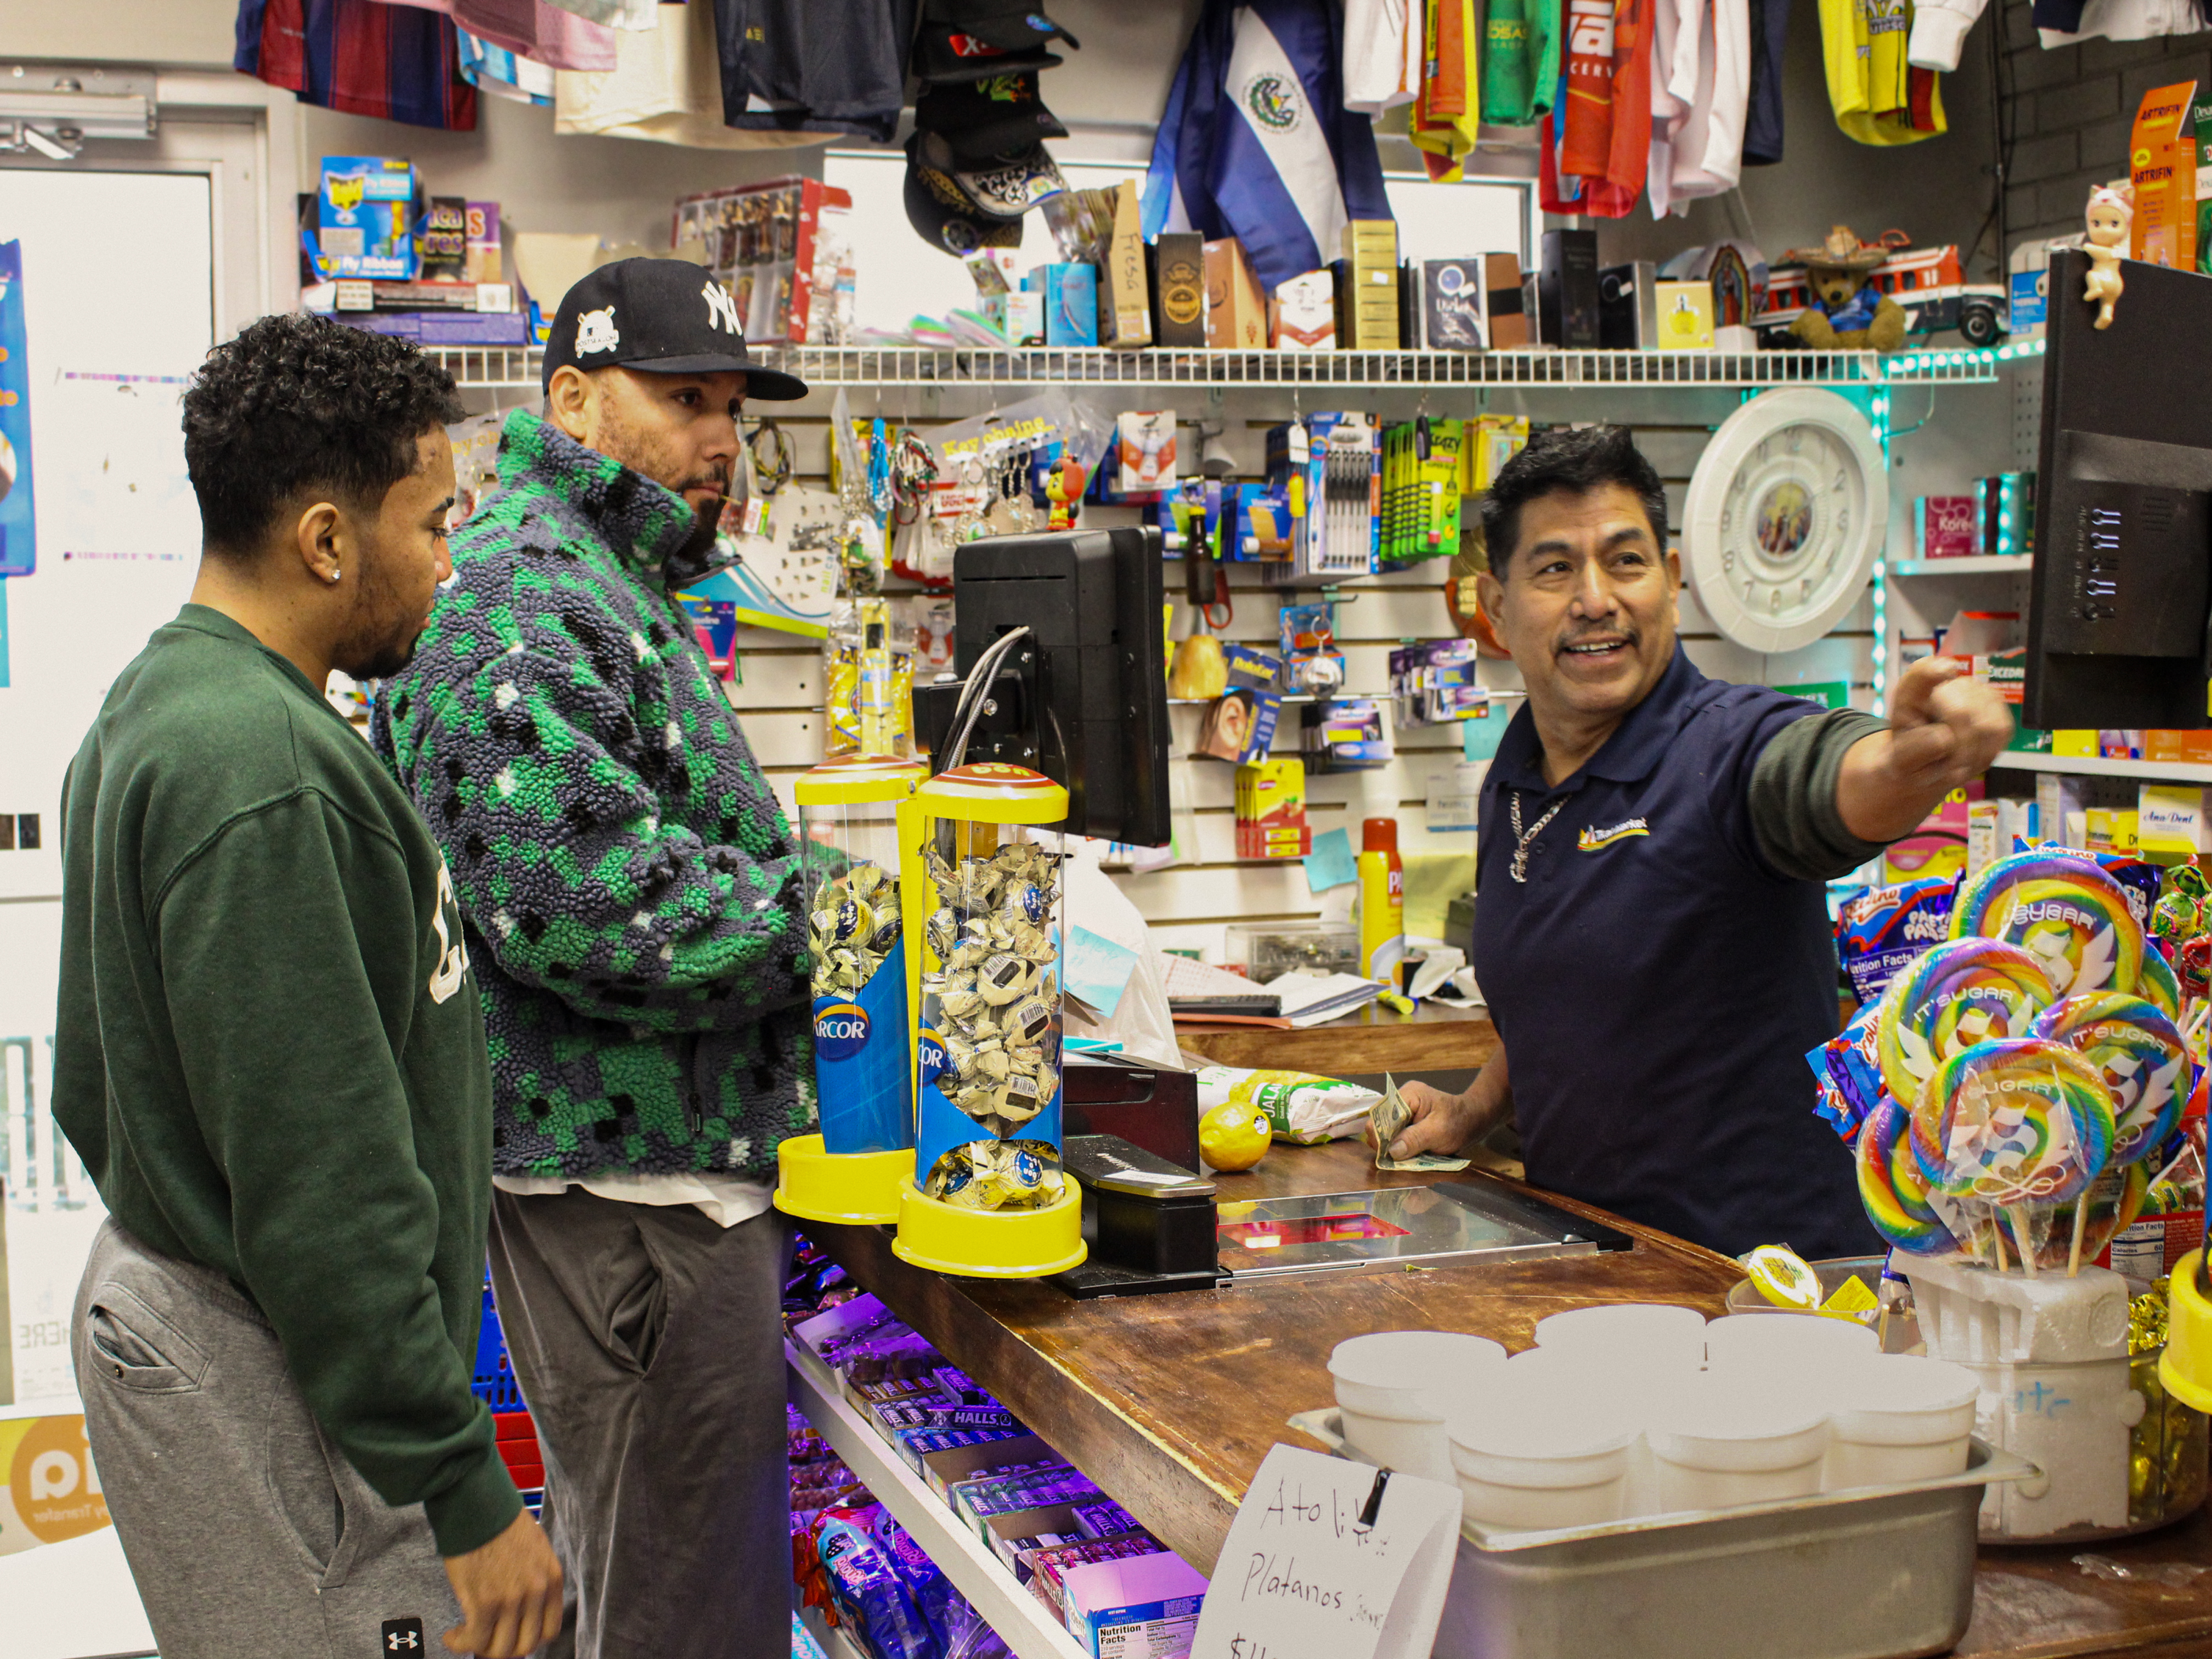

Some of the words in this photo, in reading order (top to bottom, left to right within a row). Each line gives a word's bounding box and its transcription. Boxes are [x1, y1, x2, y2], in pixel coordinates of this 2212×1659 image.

[2141, 104, 2181, 120] ARTRIFIN
[2135, 166, 2173, 183] ARTRIFIN
[701, 281, 742, 336] NY
[970, 765, 1031, 777] bon
[1882, 952, 1914, 968] Facts
[955, 1412, 998, 1424] HALLS
[911, 1437, 934, 1454] HALLS
[1090, 1512, 1113, 1533] HALLS
[994, 1541, 1015, 1573] HALLS
[1041, 1573, 1057, 1605] HALLS
[1242, 1553, 1342, 1609] Platanos
[1099, 1624, 1141, 1637] Nutrition
[1100, 1635, 1126, 1645] Facts
